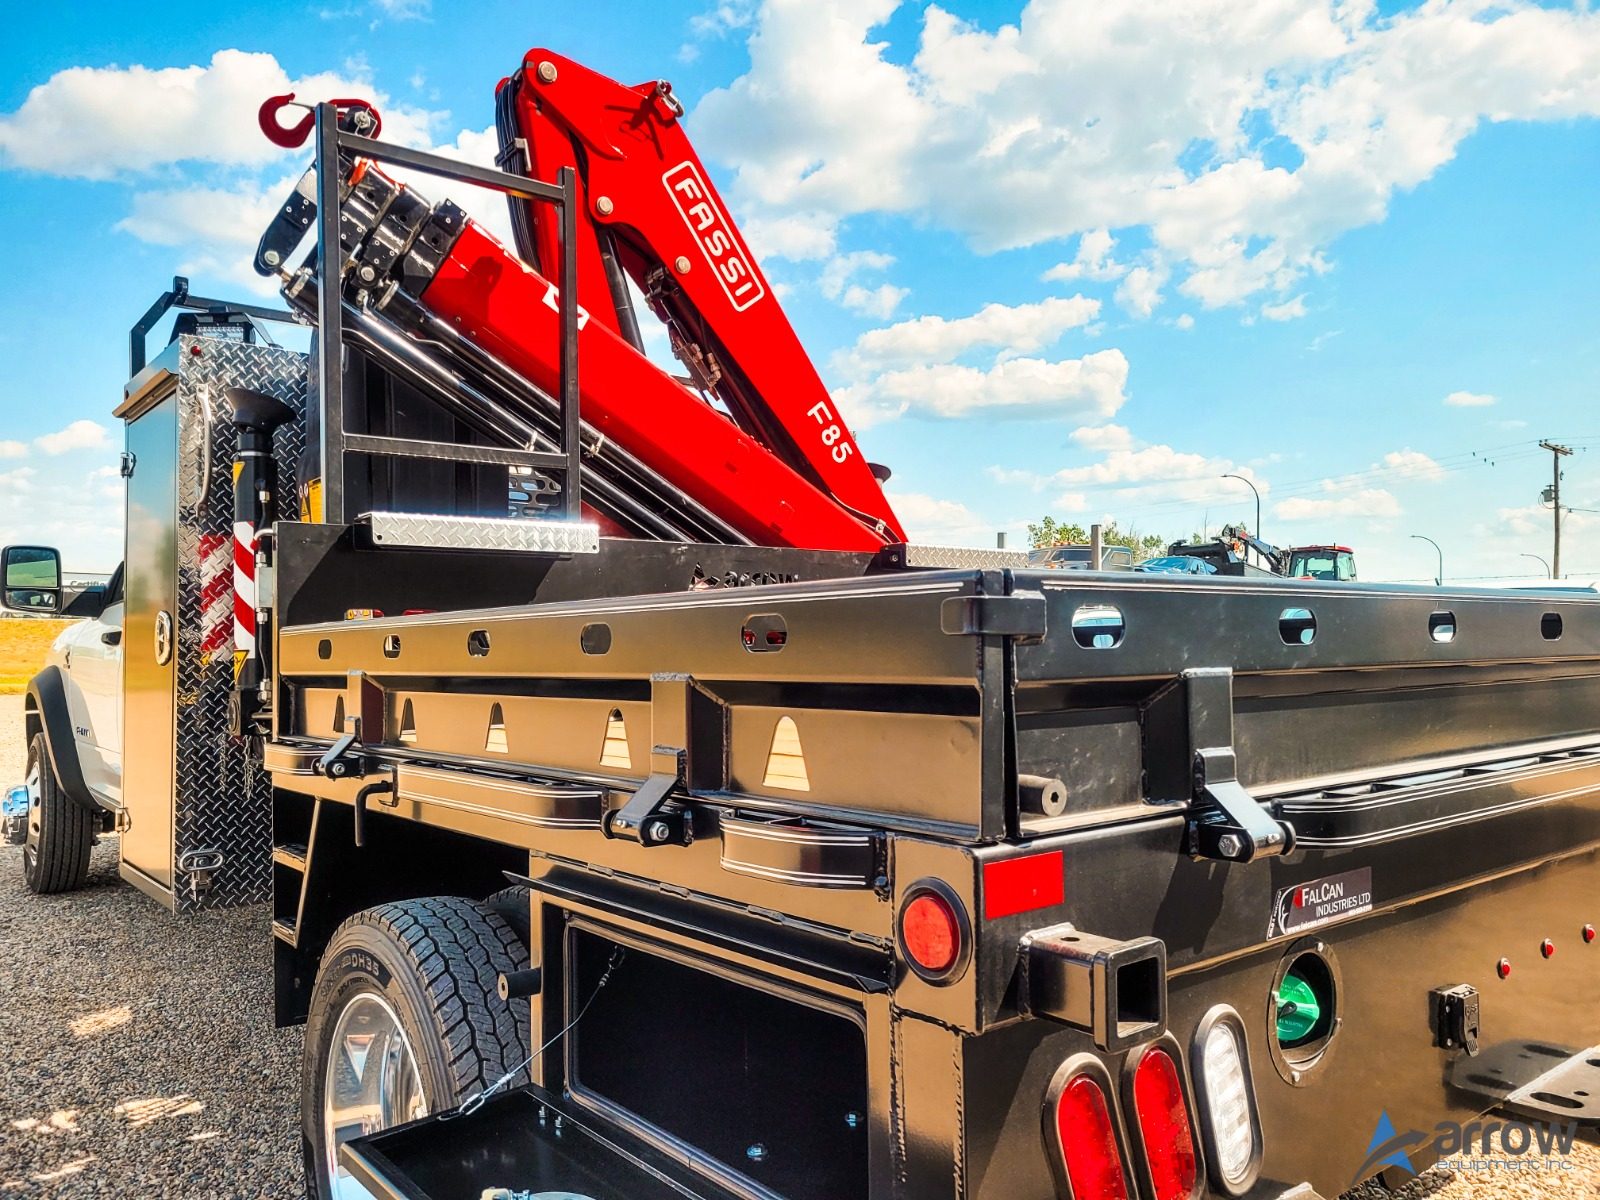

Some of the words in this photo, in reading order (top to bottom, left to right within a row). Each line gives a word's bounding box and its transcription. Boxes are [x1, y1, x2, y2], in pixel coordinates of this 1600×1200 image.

[674, 177, 753, 297] FASSI
[806, 401, 853, 464] F85
[1315, 895, 1358, 918] INDUSTRIES
[1358, 892, 1371, 905] LTD
